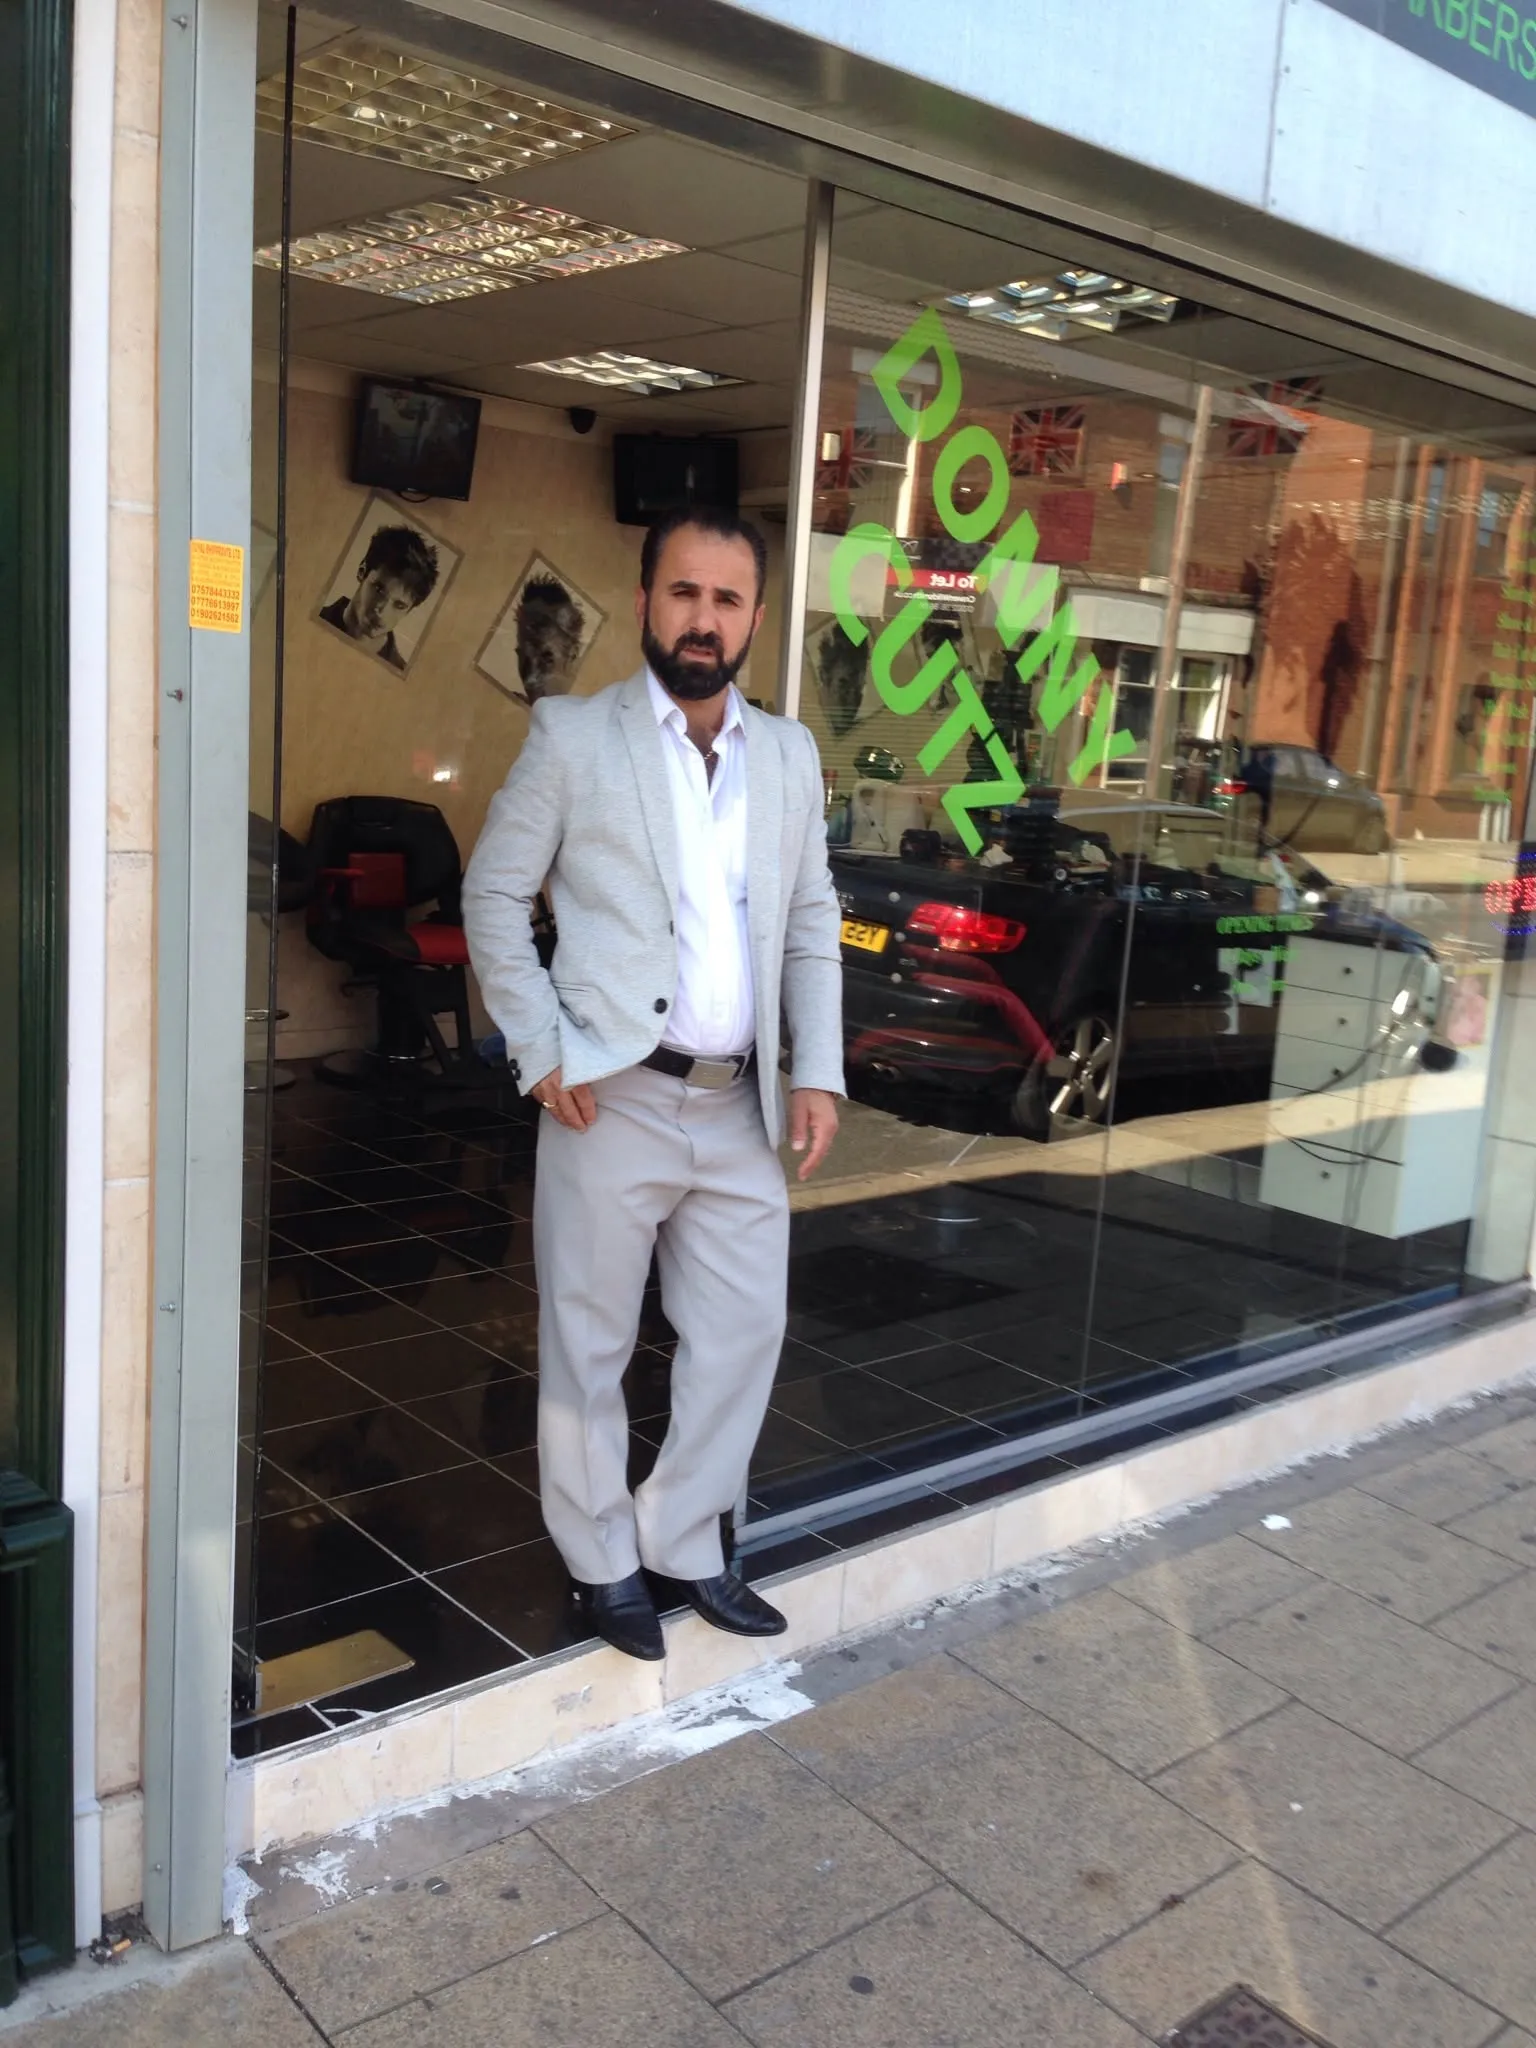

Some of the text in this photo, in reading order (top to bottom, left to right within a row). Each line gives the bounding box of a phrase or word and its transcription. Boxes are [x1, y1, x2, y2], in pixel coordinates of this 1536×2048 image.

[1408, 0, 1536, 80] BERS
[829, 522, 1026, 858] CUTZ
[871, 307, 1137, 787] DONNY
